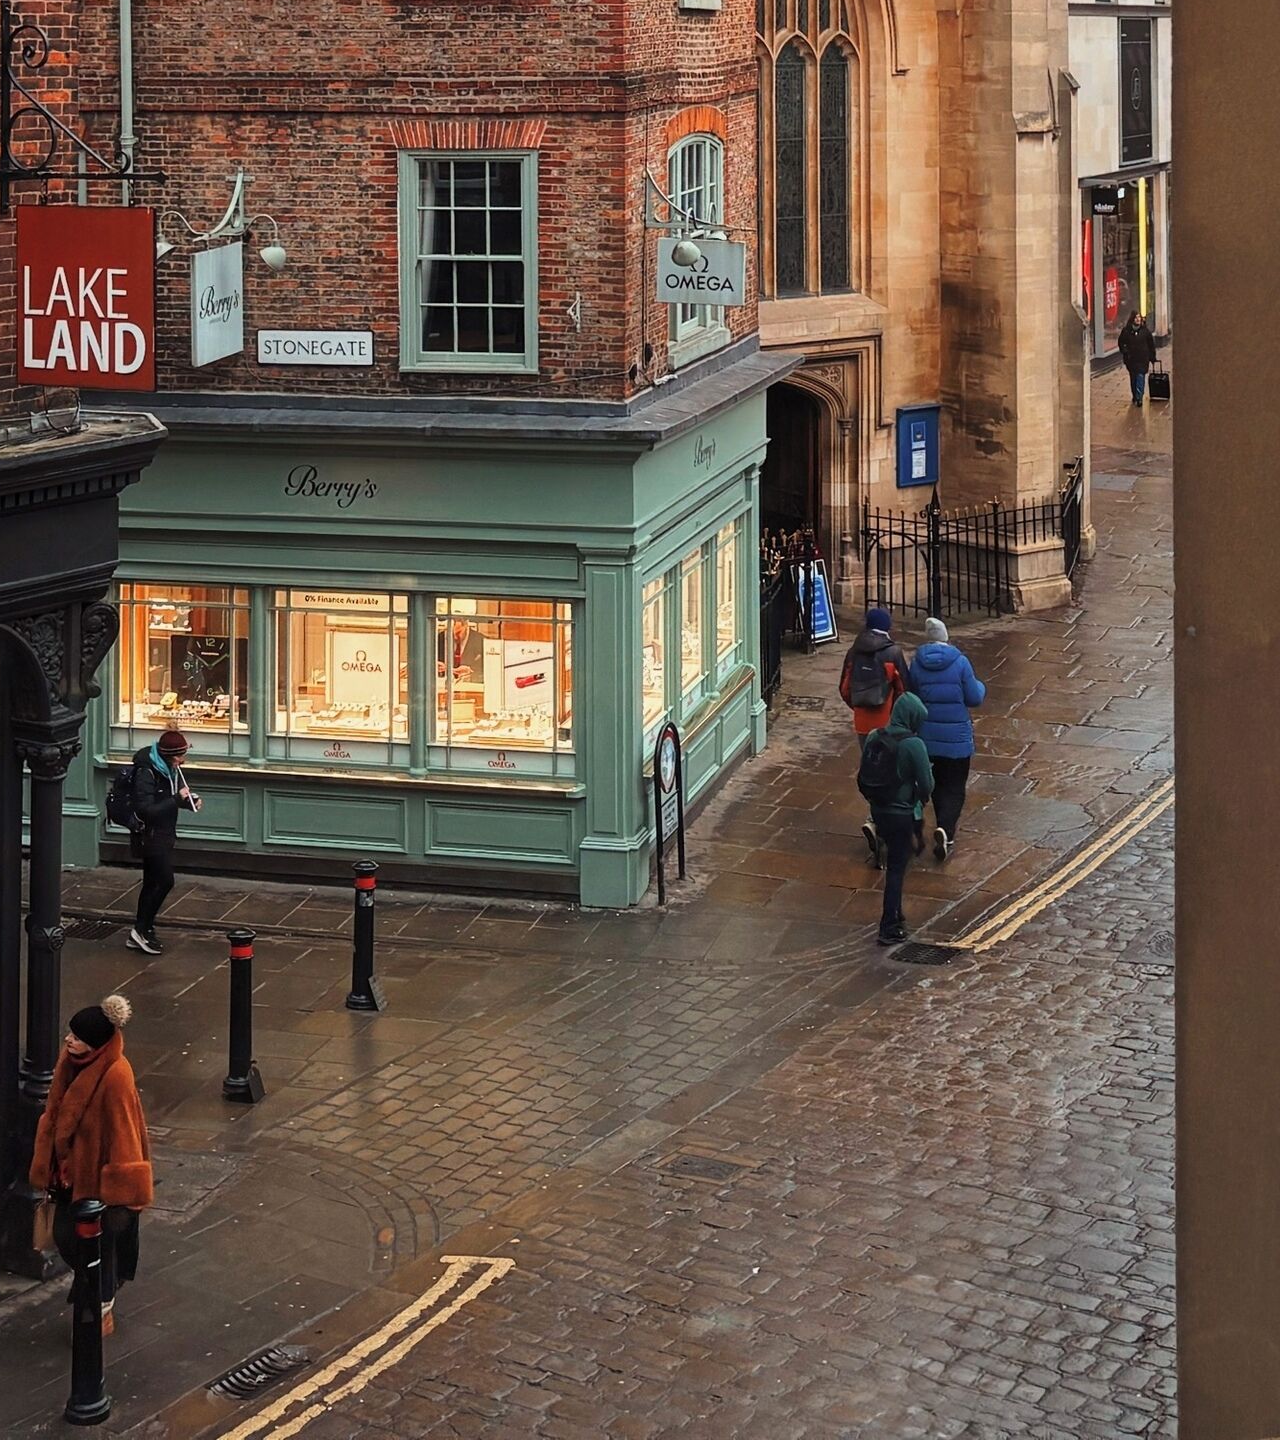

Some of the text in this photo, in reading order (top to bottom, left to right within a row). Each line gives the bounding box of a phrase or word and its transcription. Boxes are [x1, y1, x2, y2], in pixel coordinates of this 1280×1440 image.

[665, 273, 734, 292] OMEGA
[23, 265, 129, 319] LAKE
[199, 285, 240, 323] Berry's
[23, 318, 146, 374] LAND
[263, 339, 367, 356] STONEGATE
[284, 464, 378, 509] Berry's
[304, 594, 379, 606] 0% Finance Available
[205, 638, 216, 647] 12
[341, 661, 382, 672] OMEGA
[323, 750, 351, 759] OMEGA
[487, 760, 516, 769] OMEGA
